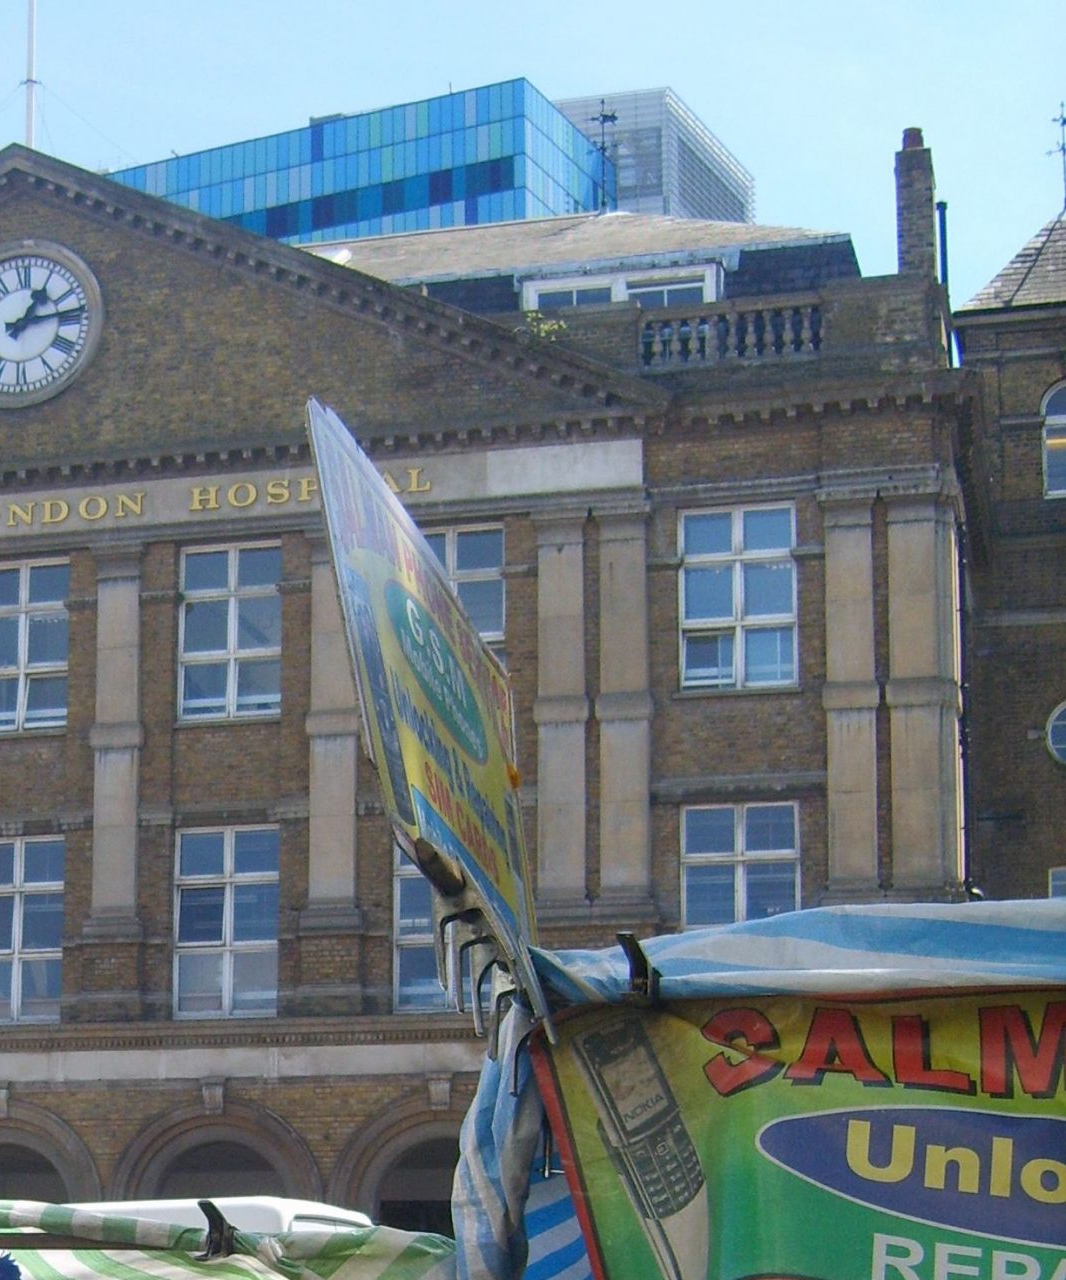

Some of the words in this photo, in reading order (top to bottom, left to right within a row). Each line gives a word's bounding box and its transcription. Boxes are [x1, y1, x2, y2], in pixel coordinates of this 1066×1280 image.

[189, 467, 432, 511] HOSPAL
[423, 757, 455, 828] SIM
[623, 1093, 664, 1122] NOKIA
[846, 1120, 1066, 1204] Unlo
